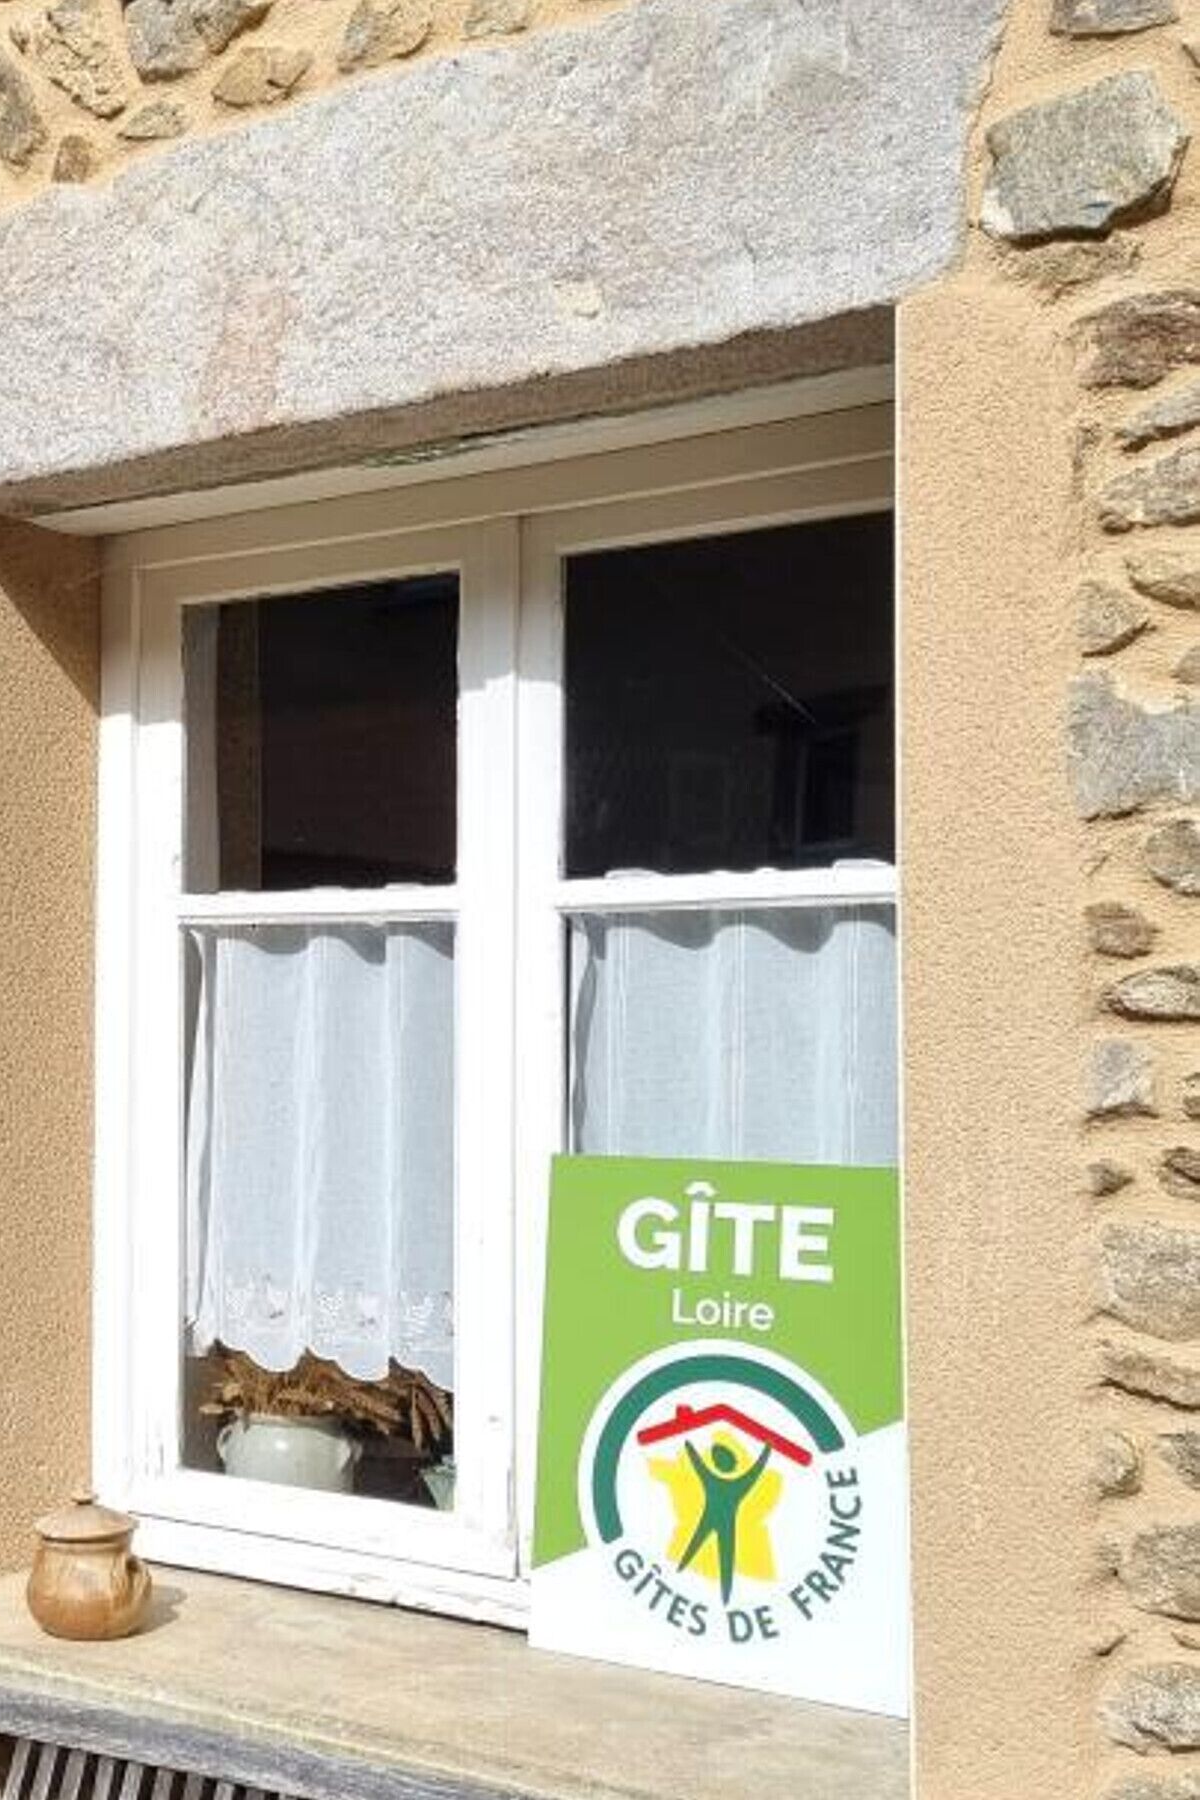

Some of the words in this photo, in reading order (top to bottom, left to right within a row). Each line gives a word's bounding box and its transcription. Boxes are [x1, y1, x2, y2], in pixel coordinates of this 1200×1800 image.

[616, 1181, 835, 1284] GÎTE
[672, 1288, 775, 1332] Loire
[614, 1548, 707, 1637] GÎTES
[728, 1605, 779, 1644] DE
[790, 1467, 862, 1621] FRANCE
